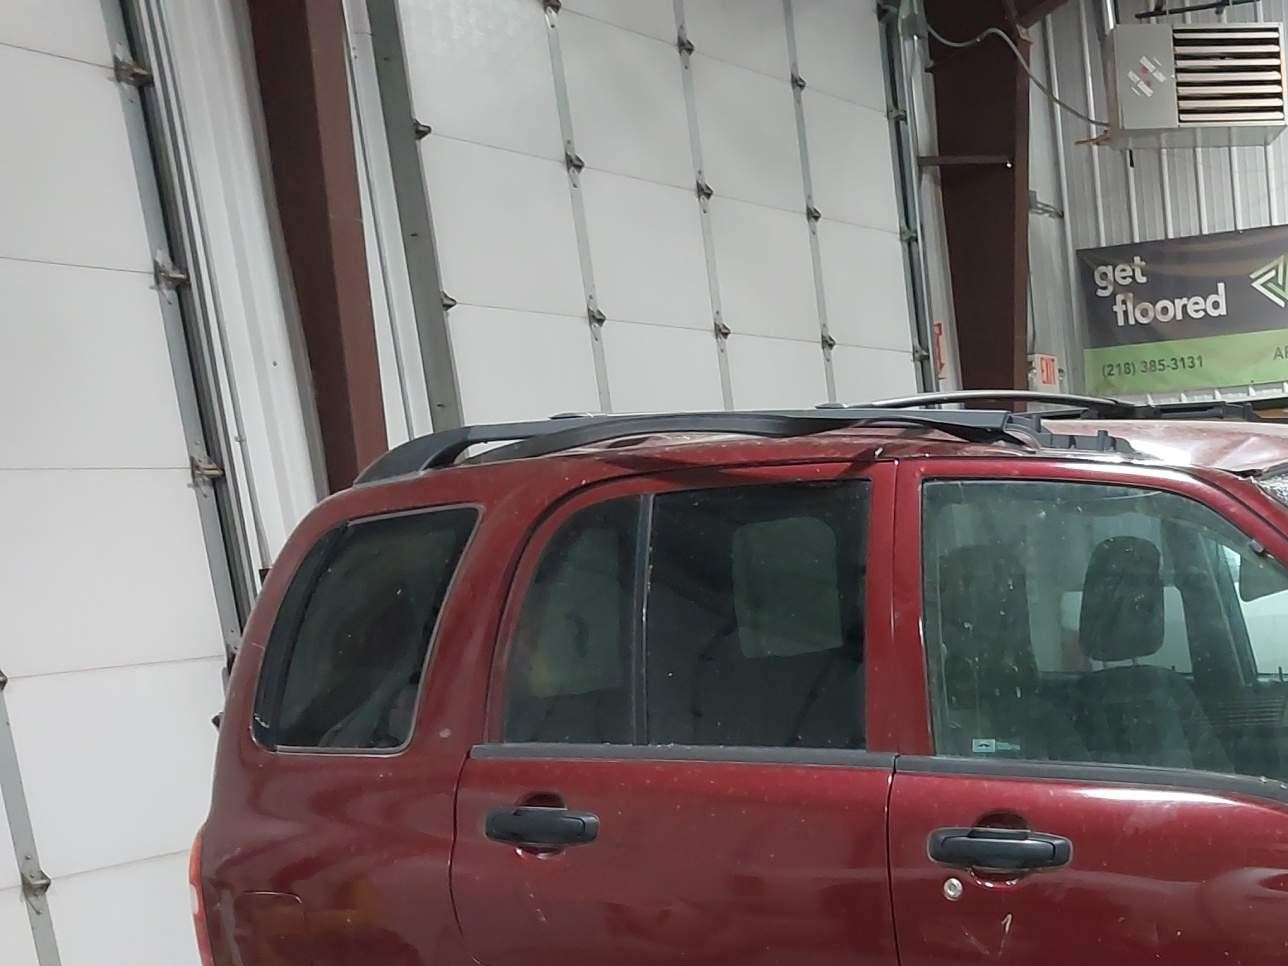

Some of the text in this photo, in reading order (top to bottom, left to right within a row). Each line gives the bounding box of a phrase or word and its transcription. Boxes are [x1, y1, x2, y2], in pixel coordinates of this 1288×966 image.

[1094, 255, 1148, 297] get
[1113, 282, 1228, 327] floored
[1102, 355, 1203, 377] (218) 385-3131
